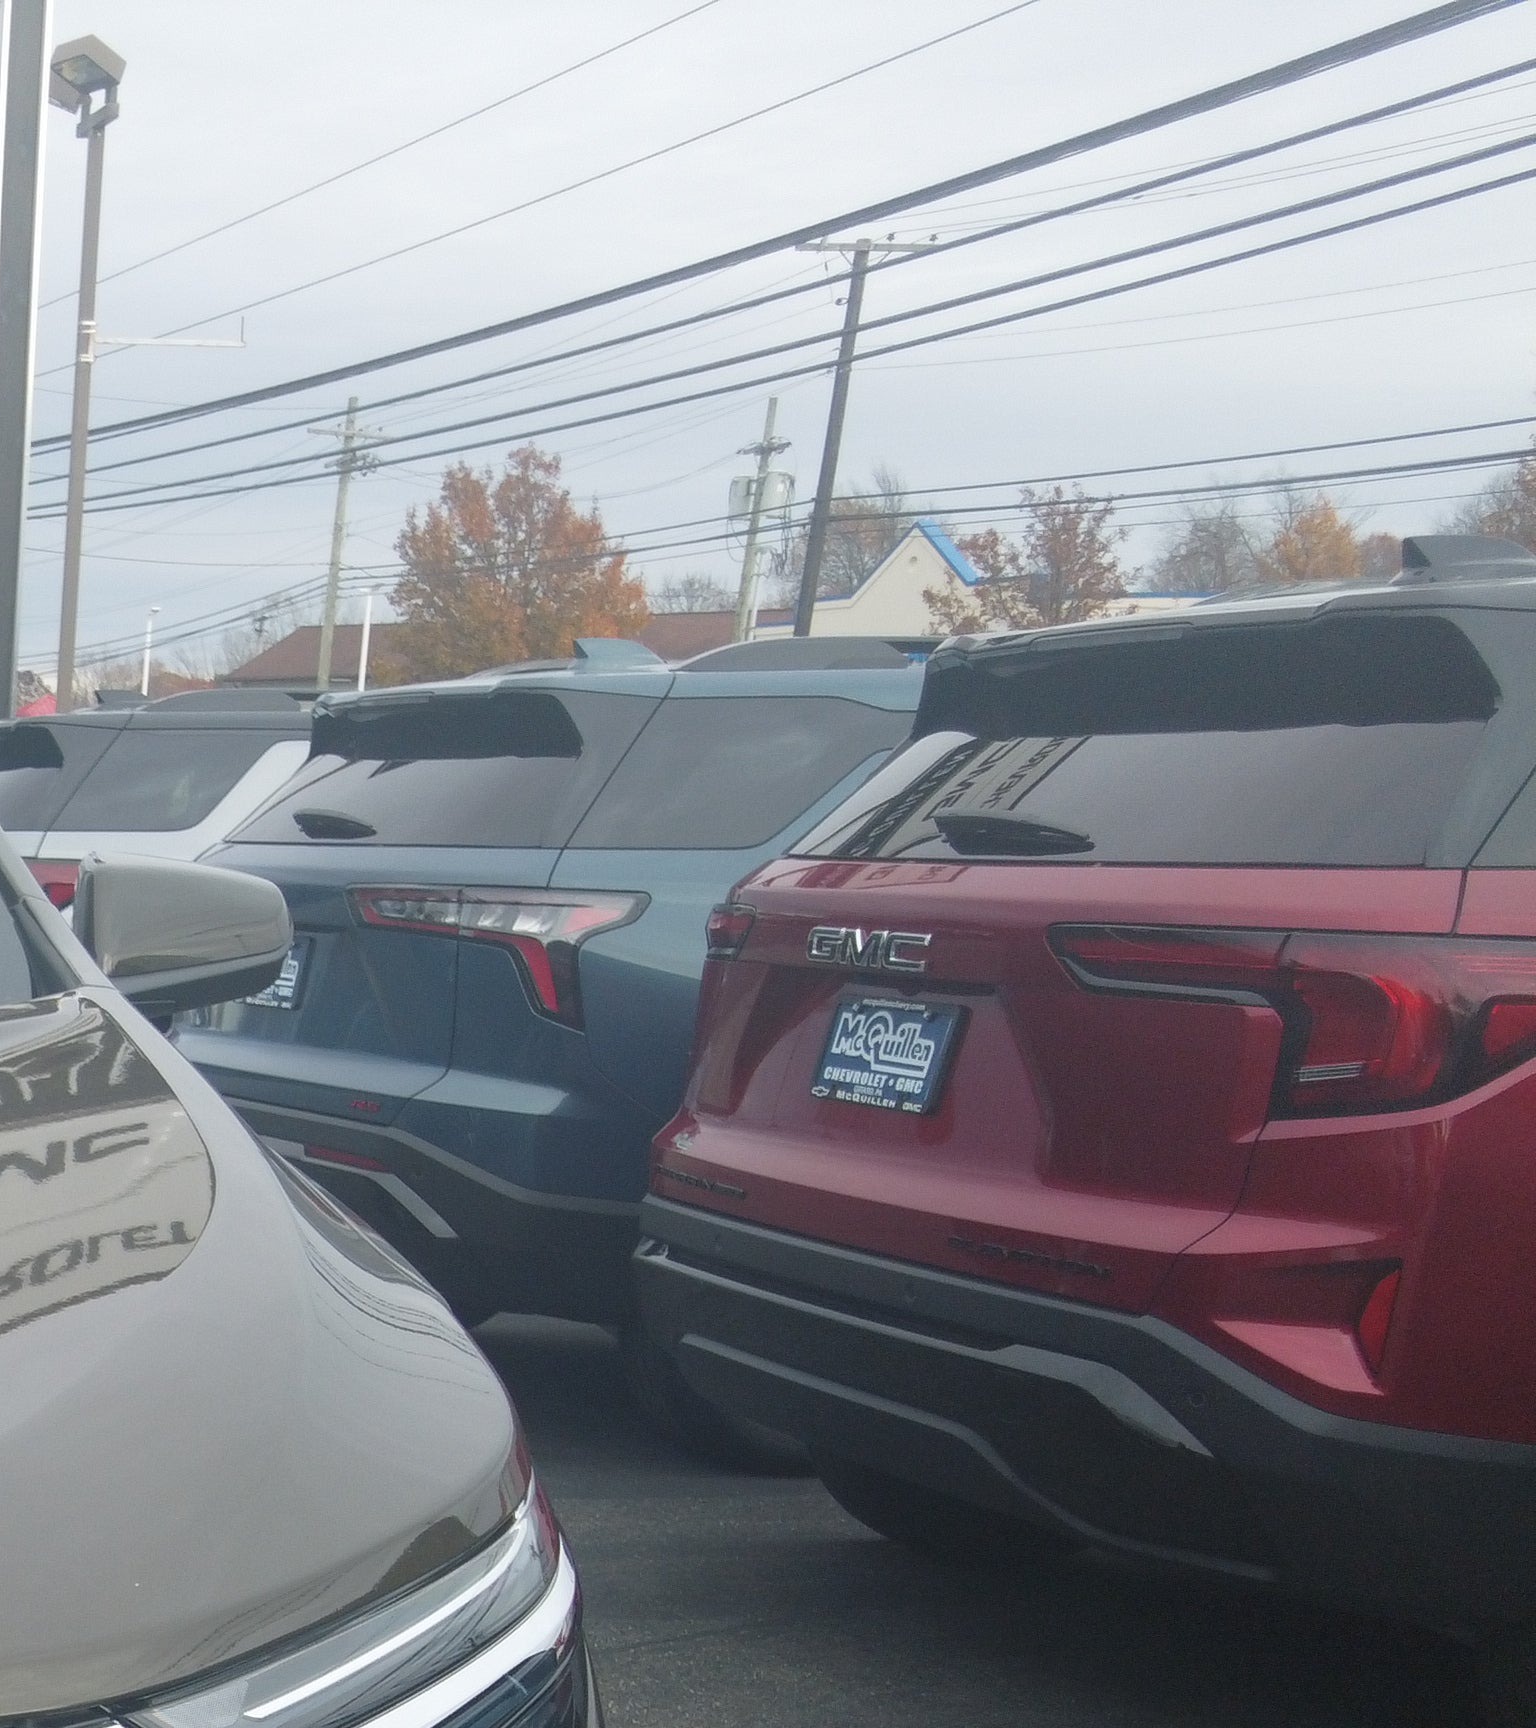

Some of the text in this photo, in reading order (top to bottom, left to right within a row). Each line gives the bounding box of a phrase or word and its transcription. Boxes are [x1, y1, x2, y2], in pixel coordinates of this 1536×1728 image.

[806, 926, 931, 972] GMC
[823, 1066, 888, 1088] CHEVROLET
[895, 1077, 924, 1094] GMC
